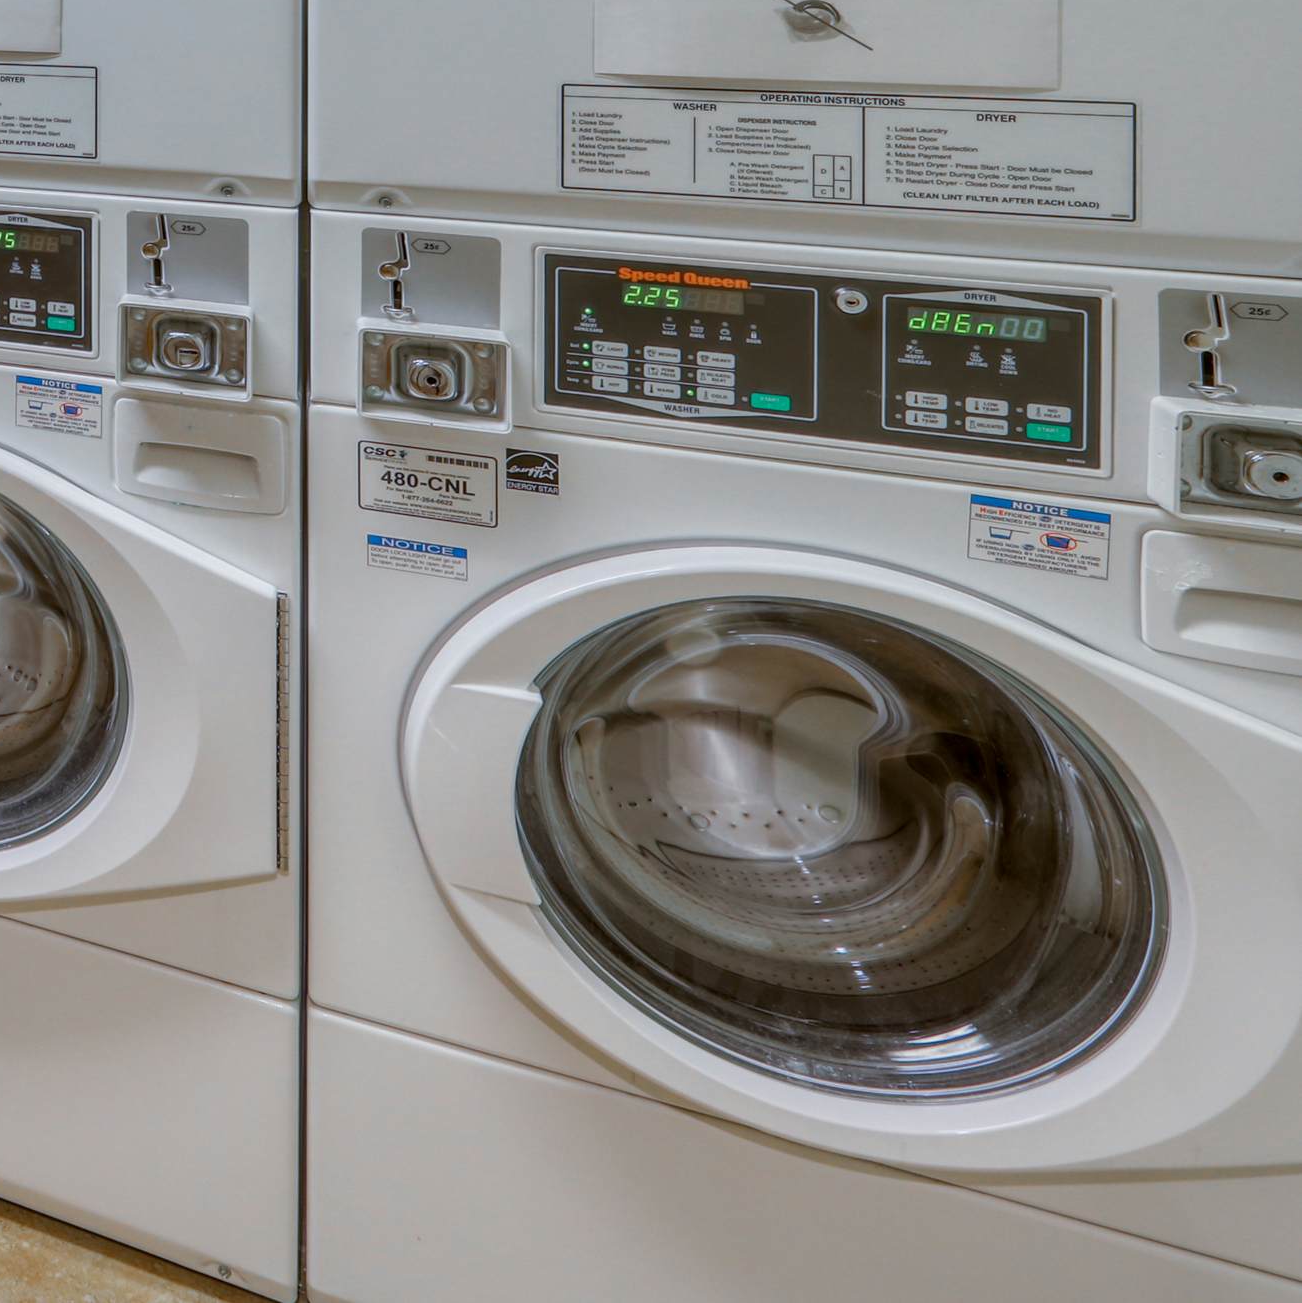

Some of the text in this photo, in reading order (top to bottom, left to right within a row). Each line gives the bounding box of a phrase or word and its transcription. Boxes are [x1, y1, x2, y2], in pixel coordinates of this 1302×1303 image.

[0, 76, 25, 84] DRYER
[761, 94, 906, 106] OPERATING INSTRUCTIONS
[673, 102, 717, 112] WASHER
[977, 113, 1017, 122] DRYER
[916, 127, 949, 135] Laundry
[918, 144, 940, 152] Cycle
[1064, 168, 1093, 176] Closed
[903, 191, 1099, 210] (CLEAN LINT FILTER AFTER EACH LOAD)
[618, 266, 749, 290] Speed Queen
[624, 285, 679, 308] 2.25
[964, 292, 997, 302] DRYER
[42, 379, 77, 390] NOTICE
[664, 404, 700, 414] WASHER
[364, 446, 397, 458] CSC
[381, 470, 475, 496] 480-CNL
[507, 482, 559, 494] ENERGY STAR
[1012, 502, 1069, 516] NOTICE
[1057, 524, 1105, 537] PERFORMANCE
[381, 538, 453, 556] NOTICE
